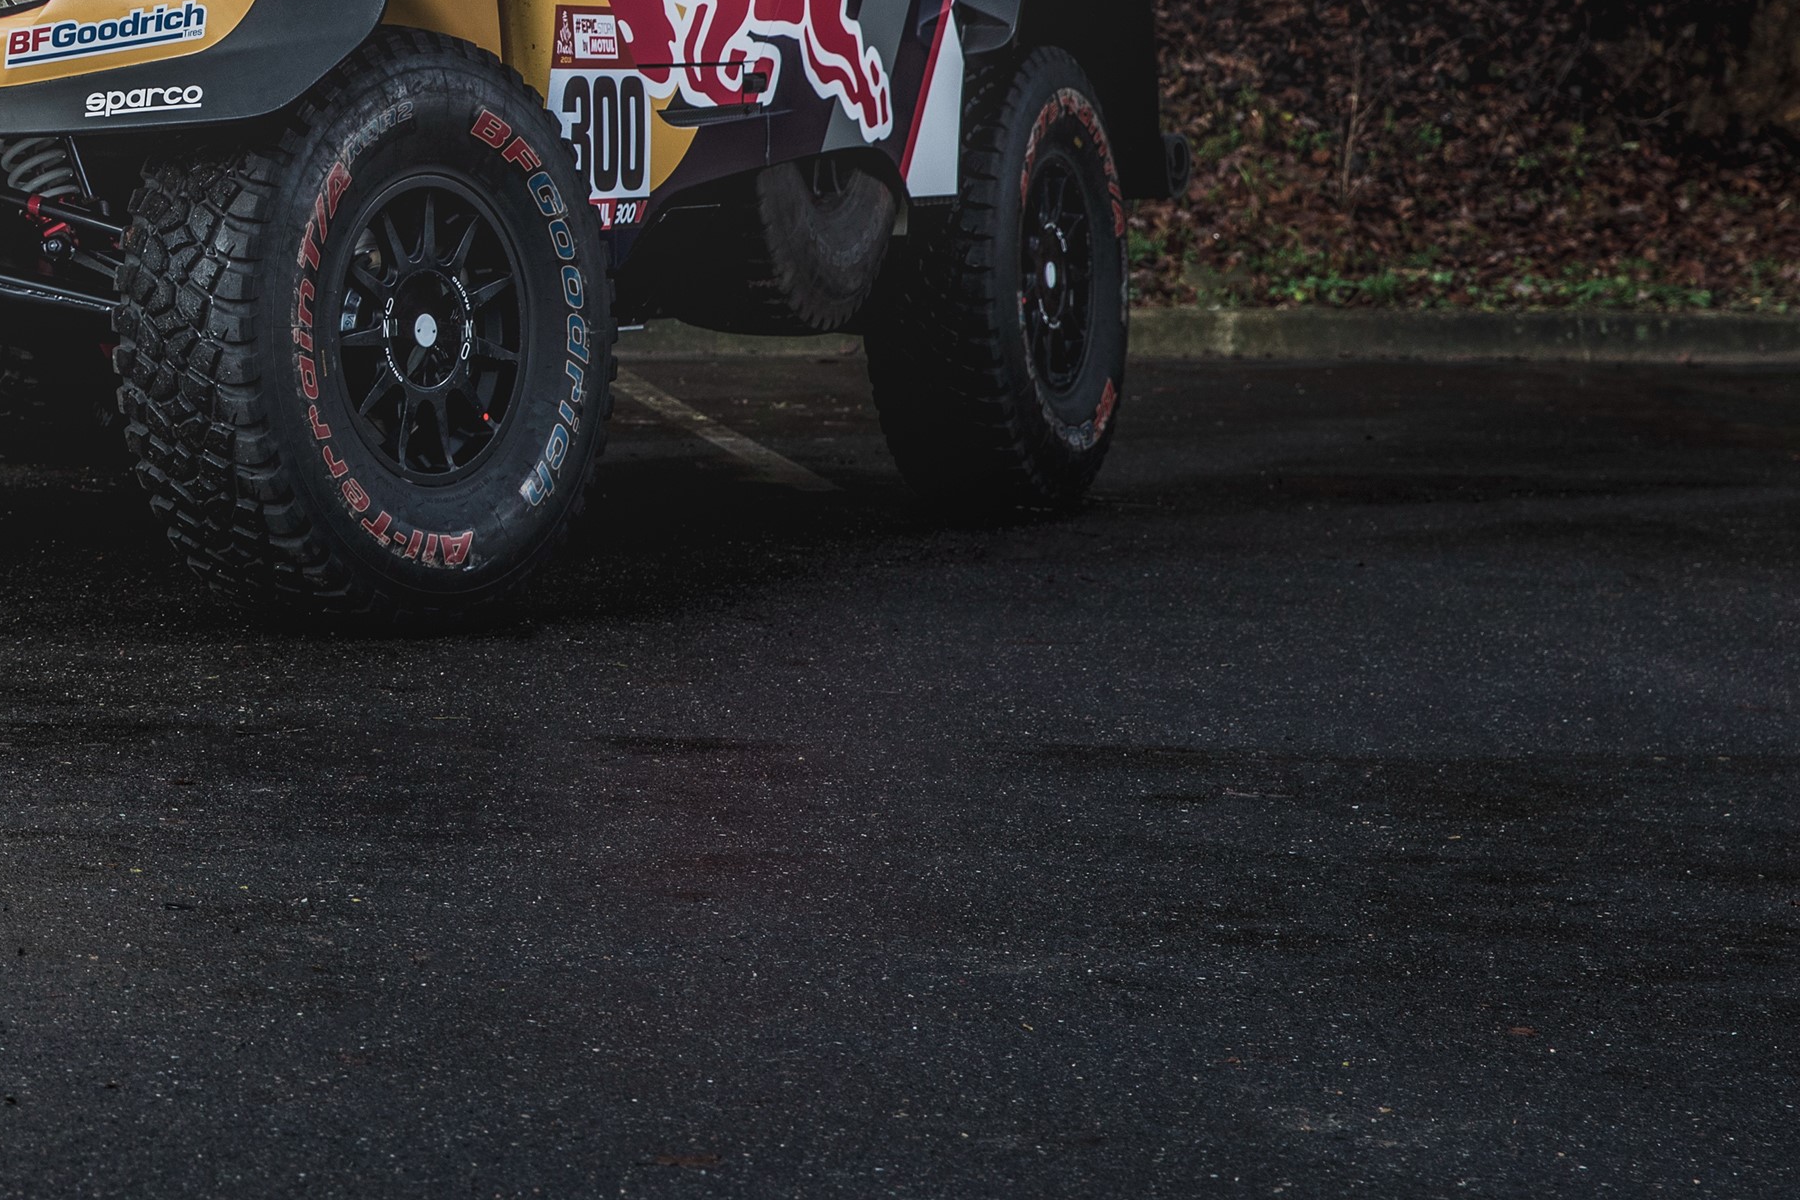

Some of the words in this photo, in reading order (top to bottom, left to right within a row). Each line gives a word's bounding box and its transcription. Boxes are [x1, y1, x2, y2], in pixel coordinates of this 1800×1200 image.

[8, 3, 204, 55] BFGoodrich
[183, 28, 203, 38] Tires
[590, 39, 615, 53] MOTUL
[85, 85, 203, 117] sparco
[563, 75, 644, 192] 300
[614, 200, 648, 225] 300V
[470, 109, 590, 507] BFGoodrich
